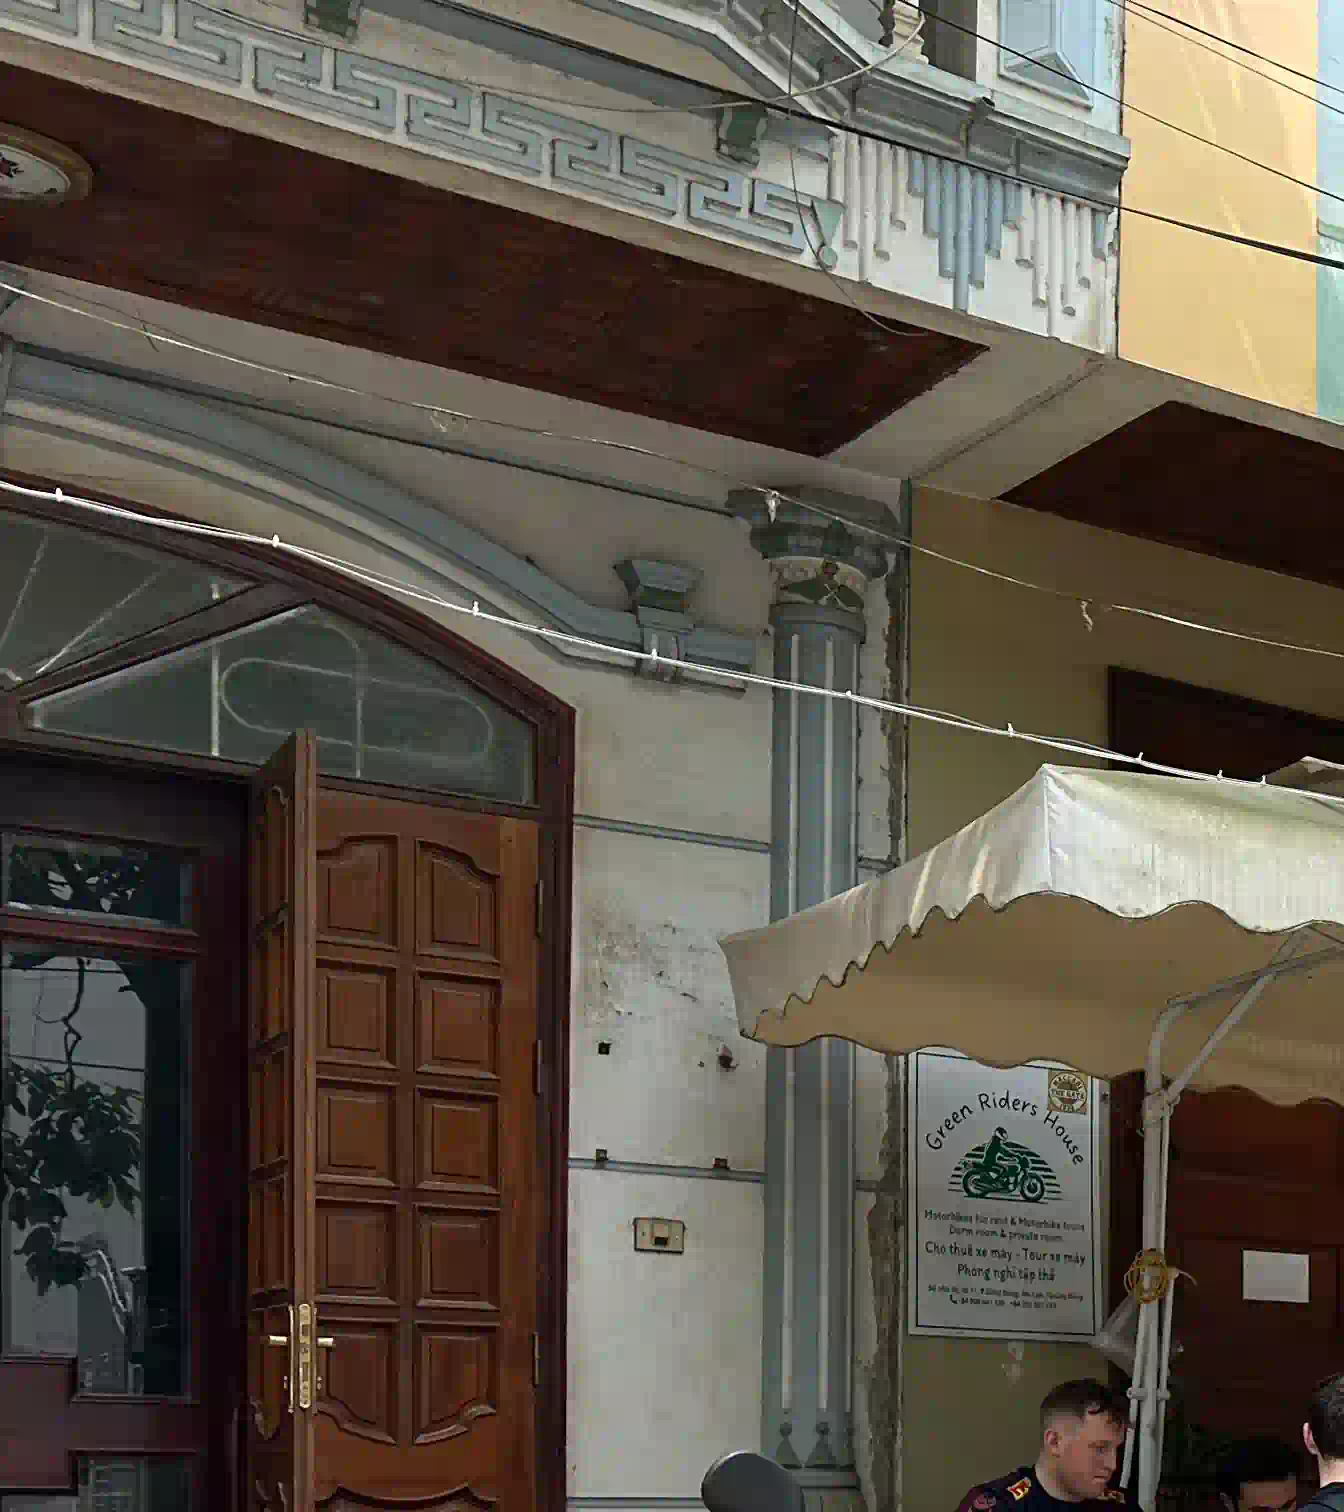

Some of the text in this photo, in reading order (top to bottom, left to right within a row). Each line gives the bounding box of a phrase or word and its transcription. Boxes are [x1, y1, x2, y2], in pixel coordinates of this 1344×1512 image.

[926, 1089, 1084, 1166] Green Riders House
[925, 1241, 946, 1254] Cho
[1021, 1247, 1048, 1261] Tour
